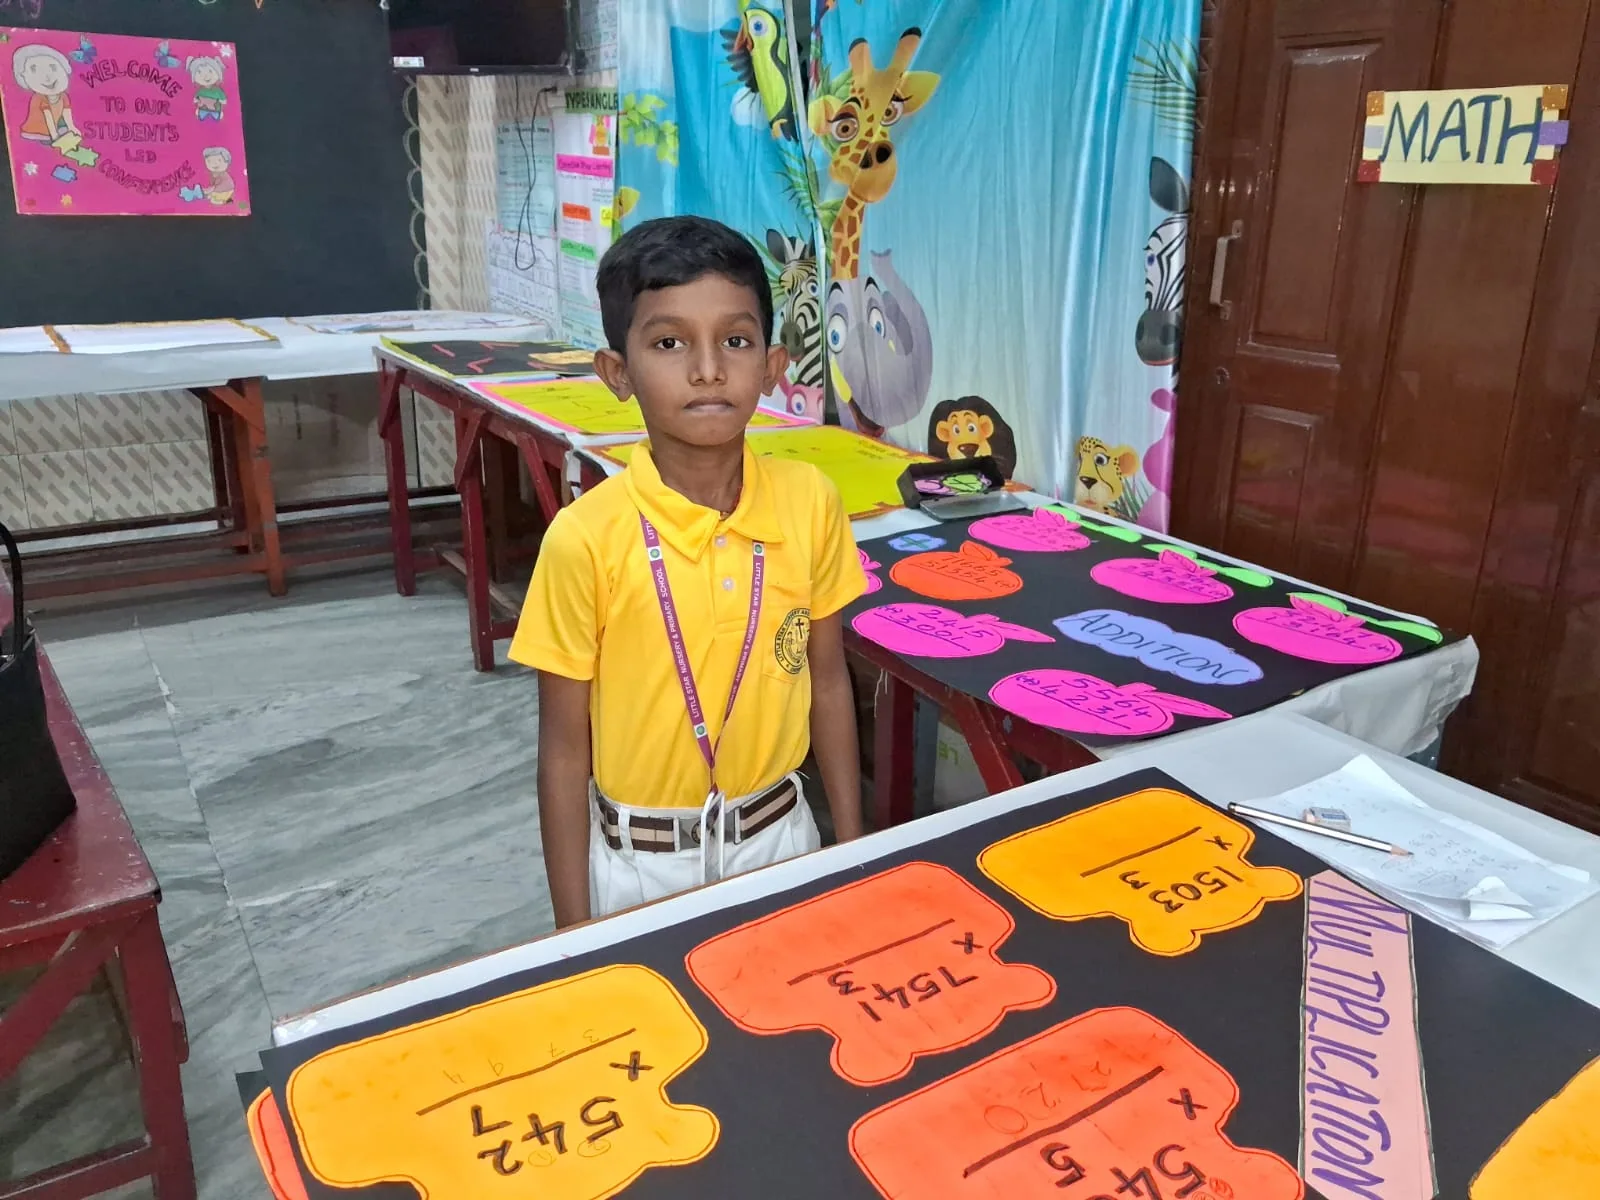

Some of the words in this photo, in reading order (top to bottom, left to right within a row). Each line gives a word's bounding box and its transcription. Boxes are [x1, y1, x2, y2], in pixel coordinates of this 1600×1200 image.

[79, 58, 183, 98] WELCOME
[100, 96, 125, 113] TO
[135, 97, 171, 116] OUR
[1378, 94, 1544, 165] MATH
[125, 148, 157, 164] LED
[656, 568, 668, 597] SCHOOL
[664, 601, 677, 632] PRIMARY
[674, 641, 687, 674] NURSERY
[1061, 613, 1249, 679] ADDITION
[683, 676, 693, 694] STAR
[1040, 685, 1128, 720] 4231
[1061, 678, 1152, 718] 5564
[688, 695, 700, 718] LITTLE
[1306, 879, 1408, 1200] MULTIPLICATION
[1039, 1142, 1086, 1188] 5
[1085, 1144, 1207, 1200] 54
